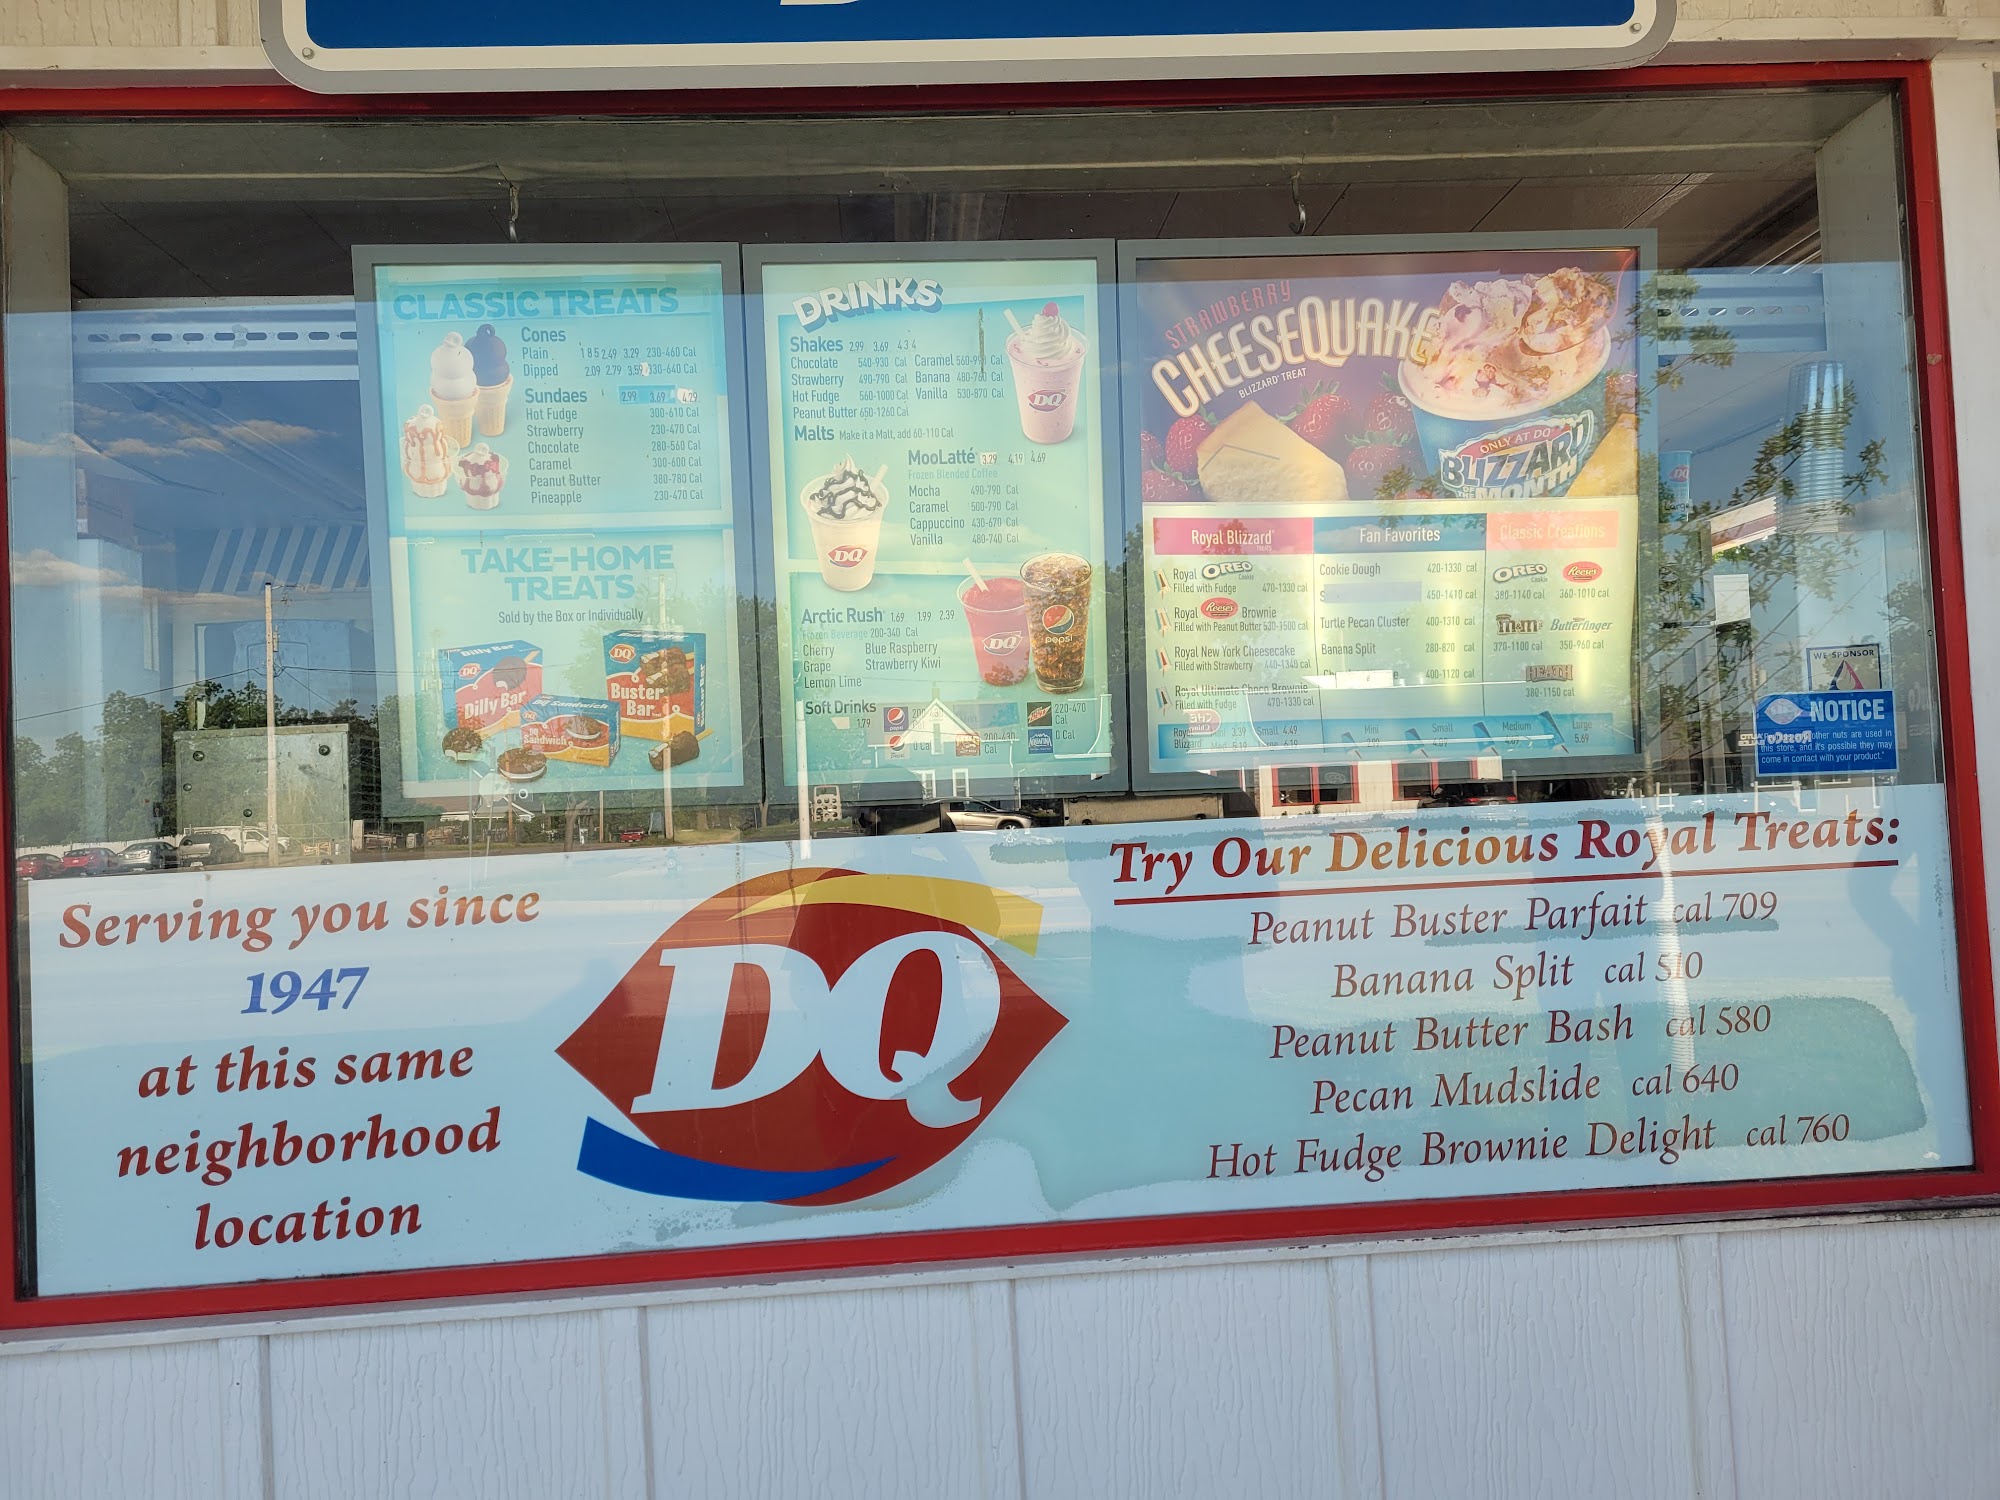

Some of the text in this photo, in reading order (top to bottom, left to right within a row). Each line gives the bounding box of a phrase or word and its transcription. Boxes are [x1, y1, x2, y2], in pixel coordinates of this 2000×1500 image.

[393, 288, 679, 320] CLASSIC TREATS
[792, 277, 941, 329] DRINKS
[1165, 279, 1293, 350] STRAWBERRY
[521, 327, 566, 342] Cones
[790, 336, 888, 352] Shakes 2.99 3.69
[791, 356, 907, 369] Chocolate 540-930 Cal
[1151, 296, 1444, 417] CHEESEQUAKE
[1239, 367, 1307, 399] BLIZZARD TREAT
[525, 388, 698, 403] Sundaes 2.99 3.69 4.29
[526, 407, 699, 421] Hot Fudge 300-610 Cal
[527, 423, 700, 438] Strawberry 230-470 Cal
[908, 447, 1046, 465] MooLatté 3.29 4.19 4.69
[532, 489, 703, 504] Pineapple 230-470 Cal
[909, 484, 1018, 496] Mocha 490-790 Cal
[1664, 503, 1689, 512] Large
[910, 516, 1018, 530] Cappuccino 430-670 Cal
[1192, 530, 1272, 546] Royal Blizzard
[1360, 528, 1440, 543] Fan Favorites
[461, 545, 673, 573] TAKE-HOME
[1202, 561, 1252, 580] OREO
[1320, 563, 1477, 576] Cookie Dough 420-1330 cal
[504, 574, 635, 602] TREATS
[1173, 583, 1308, 594] Filled with Fudge 470-1330 cal
[498, 608, 643, 625] Sold by the Box or Individually
[802, 607, 955, 624] Arctic Rush 1.69 1.99 2.39
[1321, 616, 1410, 628] Turtle Pecan Cluster
[1550, 619, 1613, 633] Butterfinger
[989, 638, 1017, 650] DQ
[1046, 635, 1073, 644] pepsi
[614, 649, 632, 659] DQ
[803, 645, 834, 657] Cherry
[865, 642, 938, 655] Blue Raspberry
[1175, 645, 1295, 658] Royal New York Cheesecake
[1322, 643, 1376, 655] Banana Split
[1832, 650, 1874, 658] SPONSOR
[866, 658, 941, 671] Strawberry Kiwi
[1526, 665, 1573, 682] HEATH
[804, 676, 862, 688] Lemon Lime
[611, 683, 664, 699] Buster
[464, 699, 497, 720] Dilly
[501, 691, 526, 709] Bar
[626, 700, 655, 716] Bar
[805, 700, 876, 715] Soft Drinks
[1811, 699, 1884, 722] NOTICE
[523, 734, 567, 745] Sandwich
[1575, 734, 1589, 743] 5.69
[1761, 744, 1773, 752] this
[1777, 744, 1796, 752] store,
[1799, 743, 1812, 751] and
[1828, 742, 1856, 751] possible
[1860, 741, 1874, 750] they
[1877, 742, 1892, 750] may
[1762, 755, 1781, 763] come
[1792, 754, 1817, 762] contact
[1820, 753, 1834, 761] with
[1835, 754, 1851, 762] your
[1110, 808, 1900, 895] Try Our Delicious Royal Treats:
[59, 885, 541, 953] Serving you since
[1248, 891, 1778, 945] Peanut Buster Parfait cal 709
[1331, 951, 1703, 1001] Banana Split cal 510
[240, 966, 370, 1015] 1947
[630, 930, 1001, 1129] DQ
[1270, 1004, 1771, 1059] Peanut Butter Bash cal 580
[138, 1045, 474, 1099] at this same
[1310, 1062, 1739, 1115] Pecan Mudslide cal 640
[118, 1105, 501, 1187] neighborhood
[1207, 1113, 1850, 1182] Hot Fudge Brownie Delight cal 760
[195, 1196, 423, 1251] location
